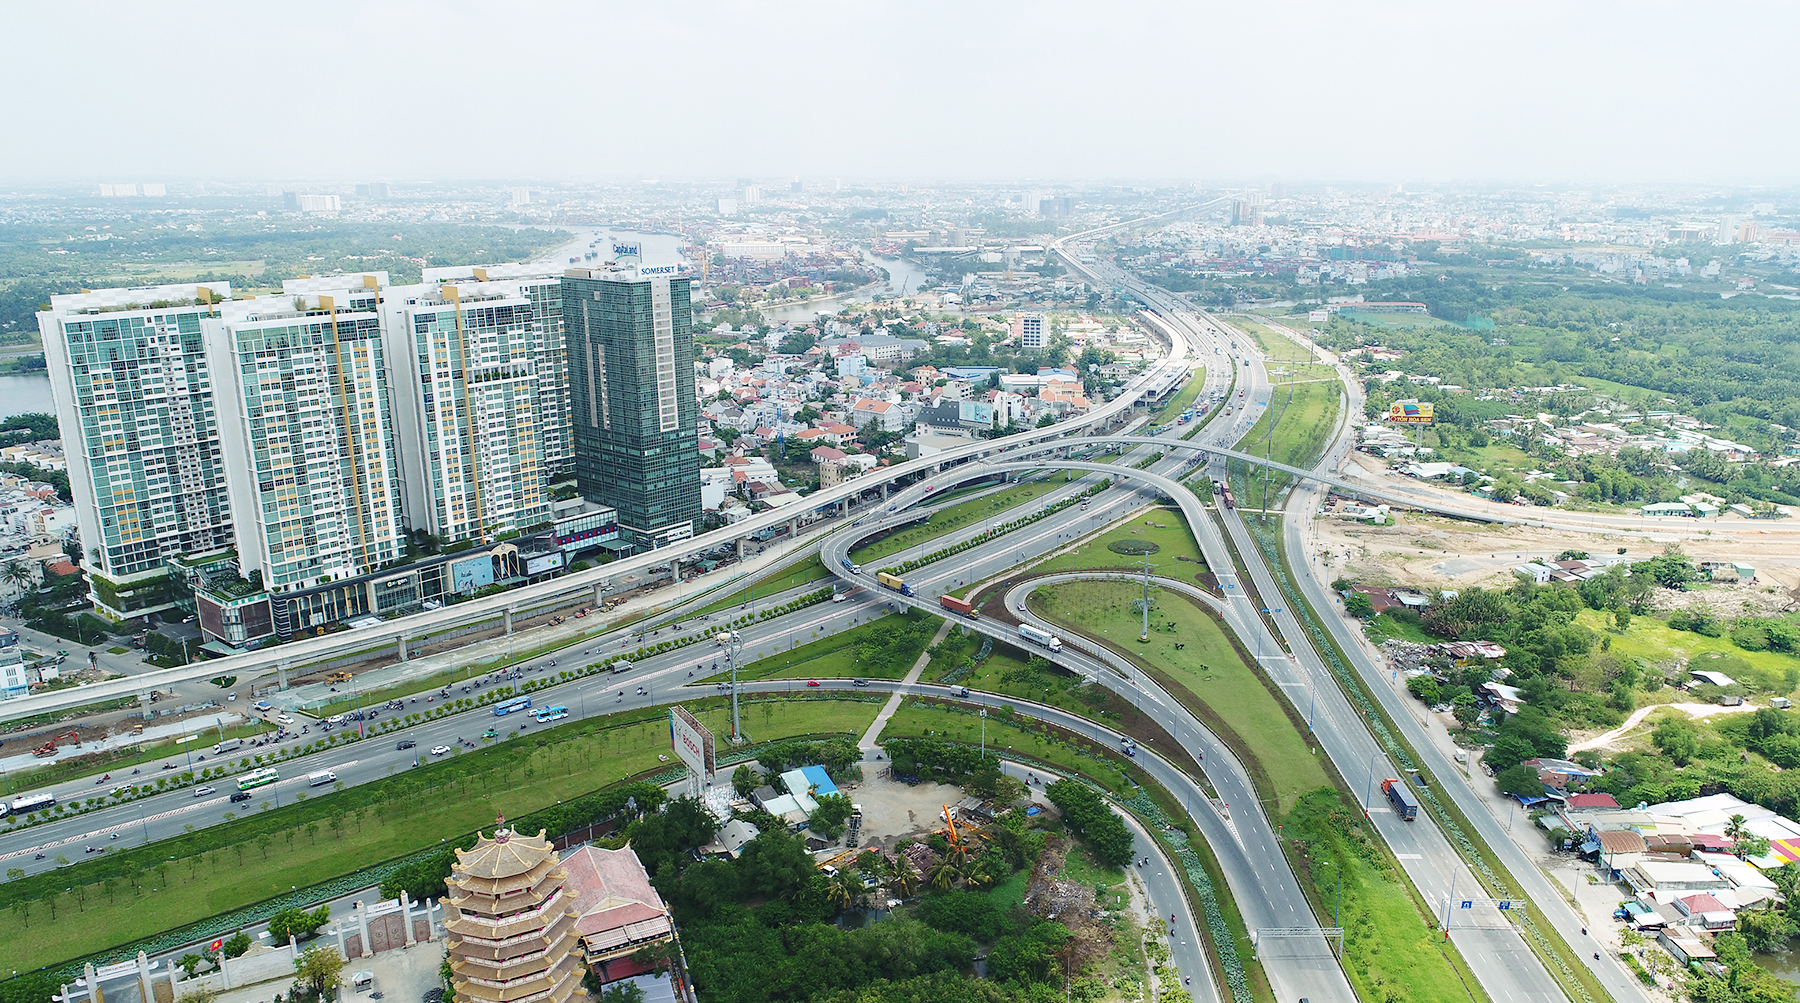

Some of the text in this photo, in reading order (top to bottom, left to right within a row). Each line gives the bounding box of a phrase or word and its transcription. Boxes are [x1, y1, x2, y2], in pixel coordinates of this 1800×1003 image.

[613, 243, 637, 255] CapitaLand
[641, 266, 675, 275] SOMERSET
[1026, 630, 1044, 640] MAERSK
[683, 734, 700, 757] BOSCH
